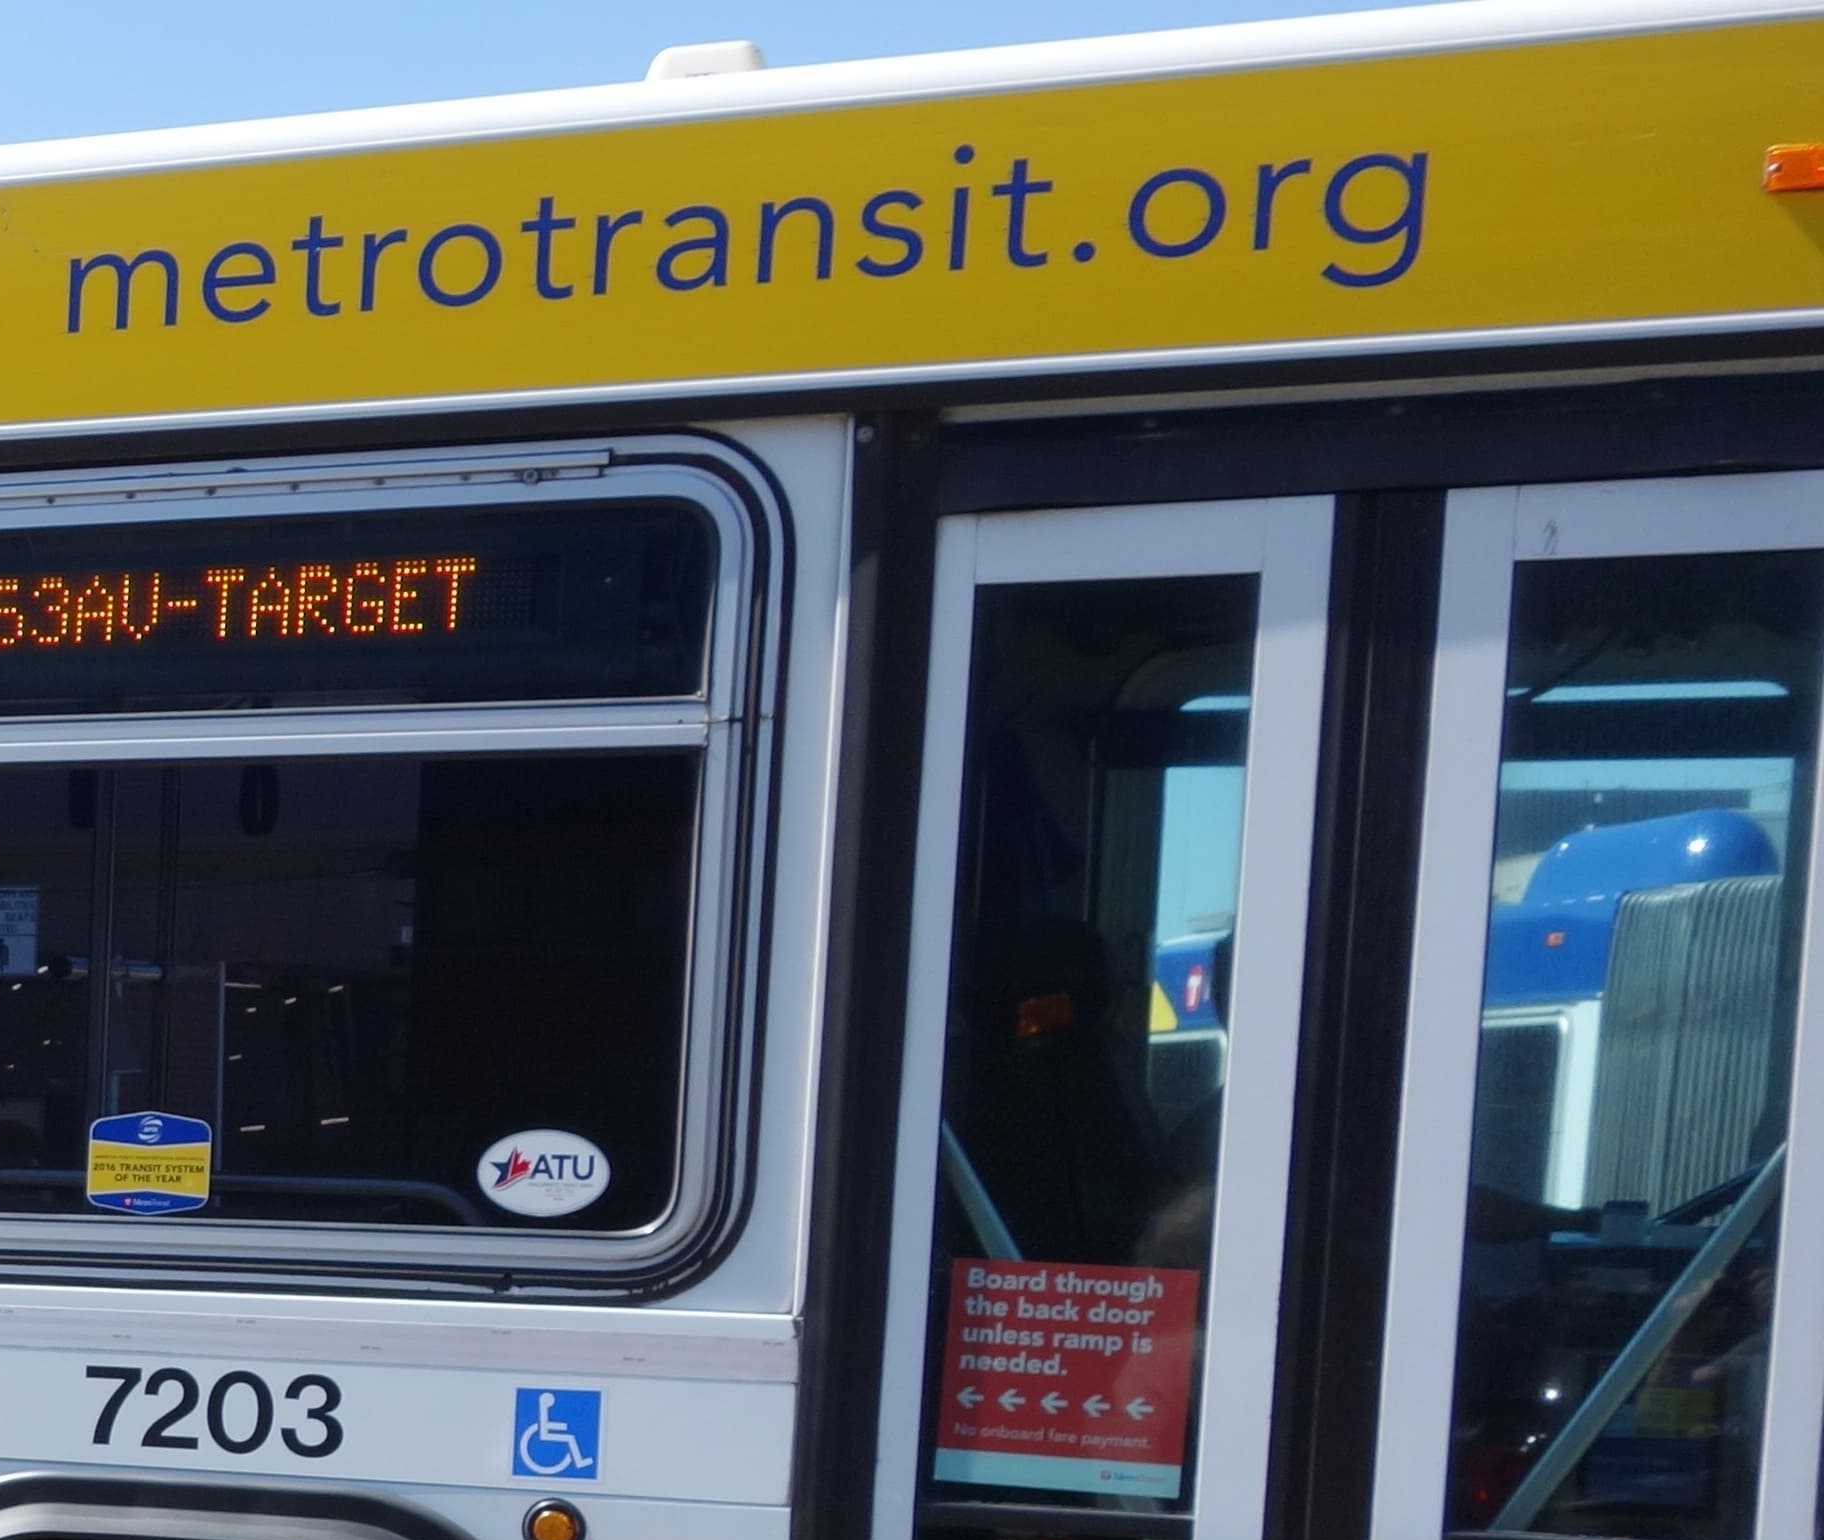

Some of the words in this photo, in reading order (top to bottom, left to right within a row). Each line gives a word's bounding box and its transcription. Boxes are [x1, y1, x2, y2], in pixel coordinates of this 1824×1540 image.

[62, 142, 1430, 334] metrotransit.org
[93, 1163, 116, 1172] 2016
[120, 1163, 161, 1173] TRANSIT
[165, 1164, 205, 1174] SYSTEM
[114, 1173, 128, 1182] OF
[132, 1173, 152, 1182] THE
[155, 1174, 183, 1183] YEAR
[530, 1153, 595, 1180] ATU
[967, 1267, 1048, 1291] Board
[1055, 1271, 1164, 1304] through
[965, 1293, 1009, 1317] the
[1017, 1296, 1080, 1321] back
[1087, 1300, 1155, 1326] door
[962, 1322, 1045, 1347] unless
[1053, 1331, 1124, 1357] ramp
[1132, 1331, 1153, 1354] is
[959, 1351, 1068, 1377] needed.
[85, 1364, 345, 1459] 7203
[954, 1421, 978, 1437] No
[979, 1424, 1045, 1442] onboard
[1048, 1428, 1077, 1445] fare
[1080, 1433, 1153, 1449] payment.
